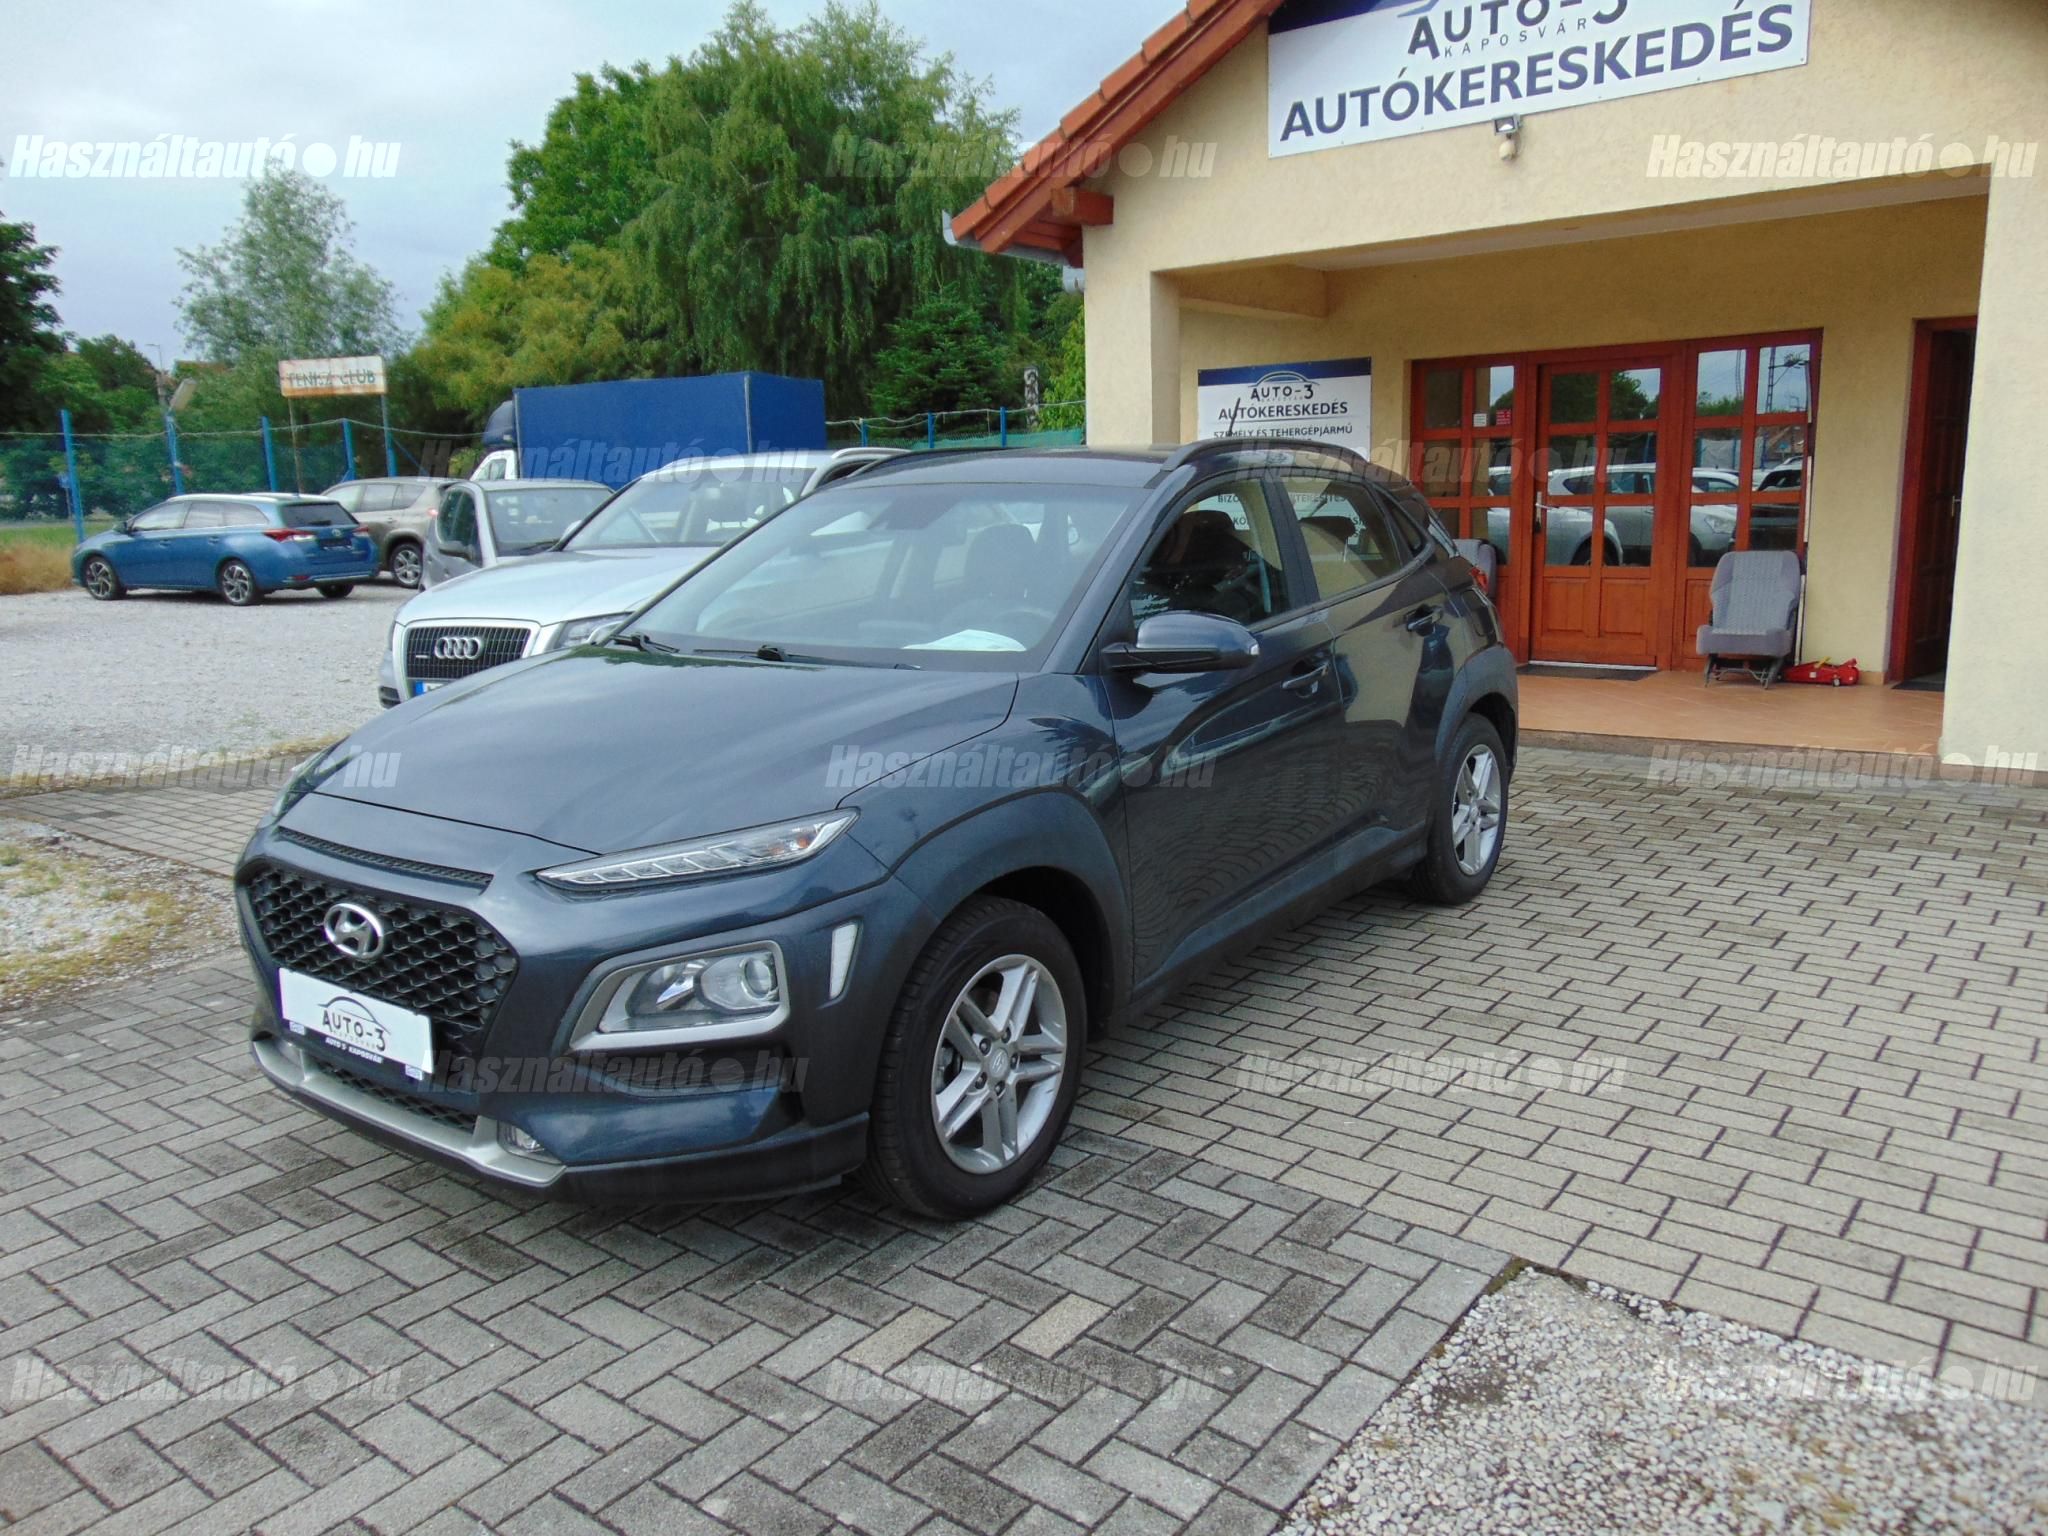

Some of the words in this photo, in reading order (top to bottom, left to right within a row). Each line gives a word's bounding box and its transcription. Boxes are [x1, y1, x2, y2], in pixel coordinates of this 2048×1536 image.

[1443, 17, 1587, 59] KAPOSVÁR
[1279, 0, 1794, 142] AUTÓKERESKEDÉS
[340, 369, 376, 385] CLUB
[1250, 384, 1314, 402] AUTO-3
[1218, 399, 1348, 420] AUTÓKERESKEDÉS
[322, 1009, 386, 1052] AUTO-3
